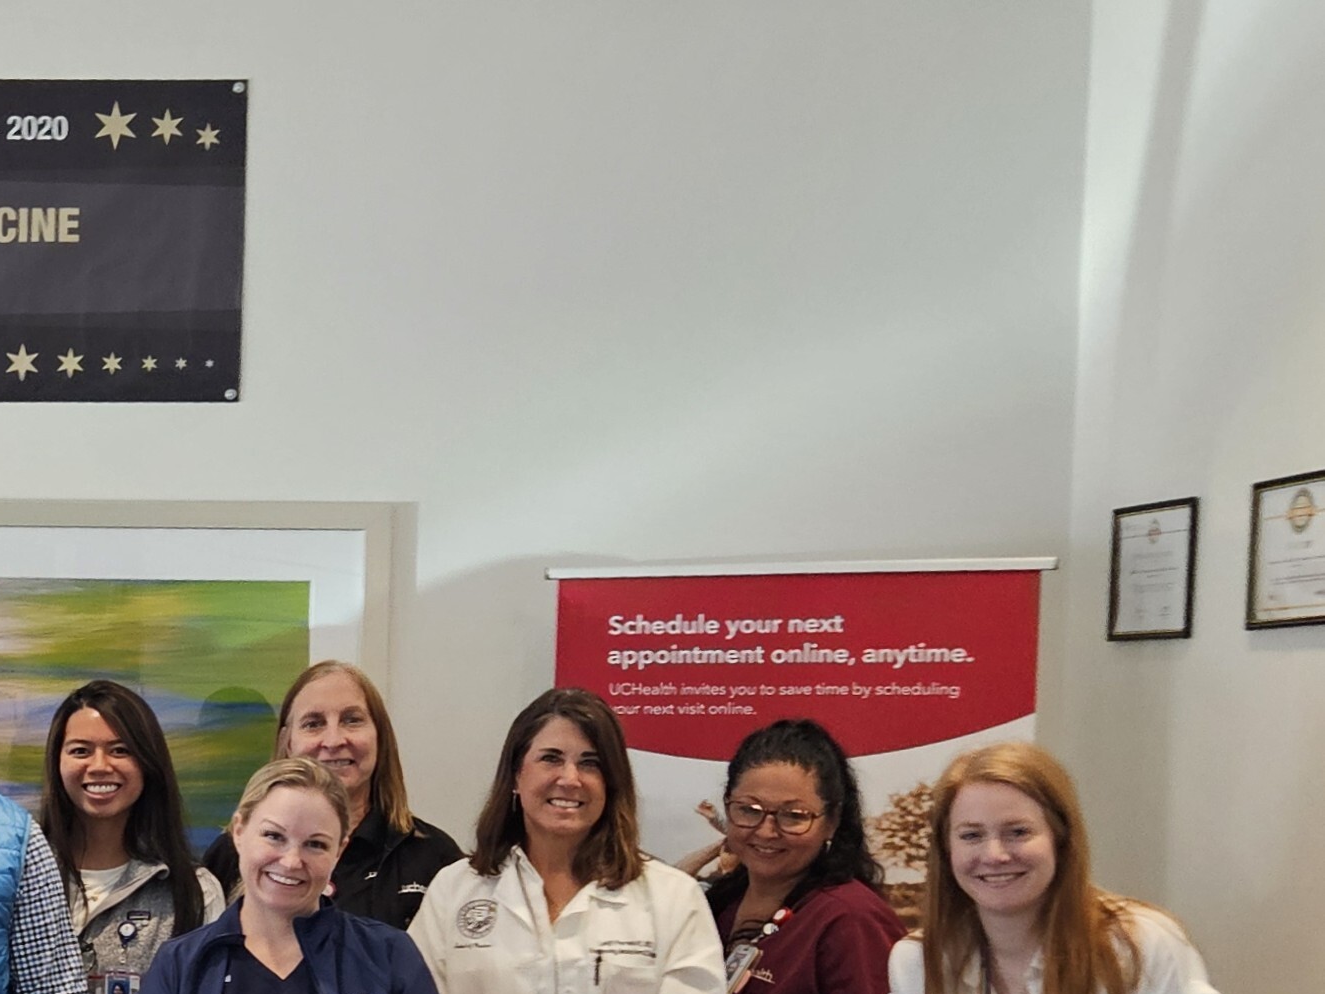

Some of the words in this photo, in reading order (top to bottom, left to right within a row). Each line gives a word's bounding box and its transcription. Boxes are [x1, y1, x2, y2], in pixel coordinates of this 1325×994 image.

[6, 115, 69, 141] 2020
[608, 613, 721, 635] Schedule
[725, 618, 783, 640] your
[787, 614, 845, 634] next
[607, 644, 765, 671] appointment
[770, 641, 856, 667] online,
[861, 642, 975, 669] anytime.
[608, 681, 678, 697] UCHealth
[680, 681, 726, 696] invites
[729, 686, 758, 699] you
[759, 683, 776, 696] to
[779, 685, 812, 696] save
[815, 681, 849, 696] time
[851, 681, 872, 699] by
[875, 681, 961, 699] scheduling
[643, 702, 675, 715] next
[677, 701, 706, 715] visit
[708, 701, 758, 716] online.
